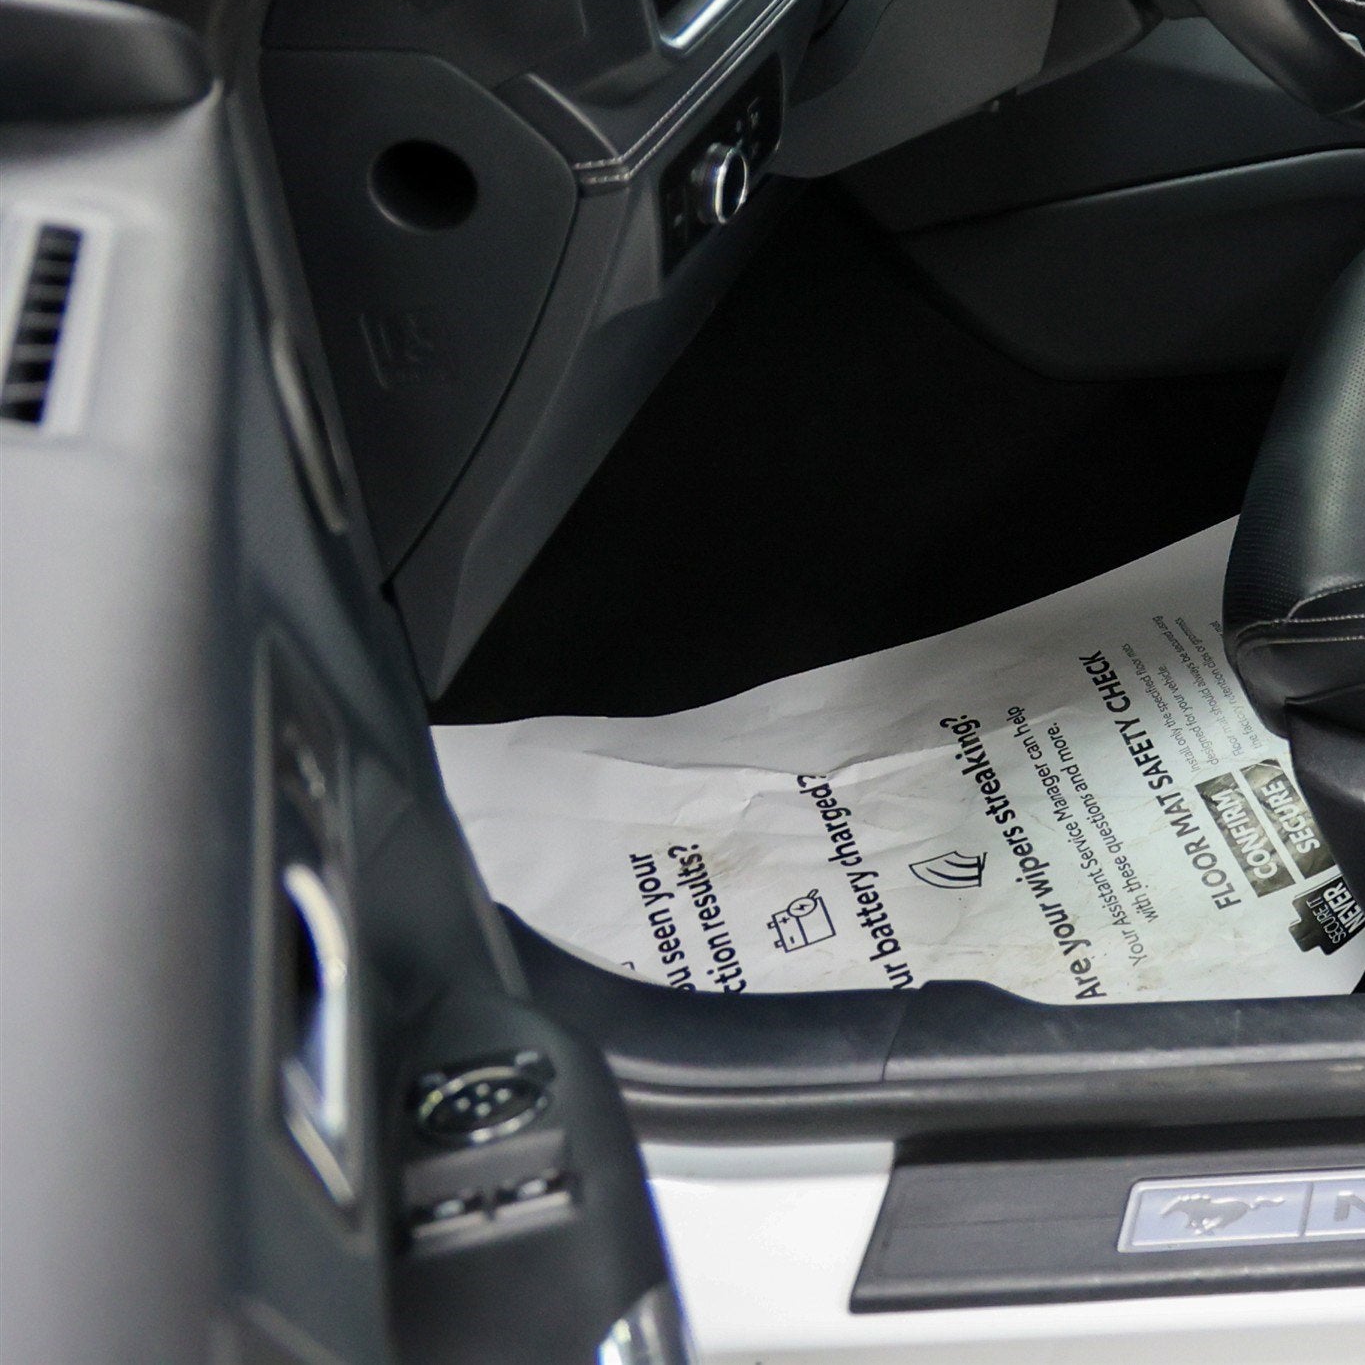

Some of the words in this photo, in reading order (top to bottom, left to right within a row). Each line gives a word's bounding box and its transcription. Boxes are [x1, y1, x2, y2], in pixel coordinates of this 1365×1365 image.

[1078, 649, 1132, 713] CHECK
[1140, 675, 1169, 713] specified
[1174, 693, 1188, 712] your
[1007, 706, 1032, 738] help
[1047, 721, 1075, 764] more.
[1168, 722, 1187, 747] only
[1191, 725, 1219, 766] designed
[938, 714, 1017, 825] streaking?
[1022, 734, 1043, 763] can
[1114, 717, 1174, 791] SAFETY
[1034, 762, 1071, 823] Manager
[1060, 762, 1088, 793] and
[796, 774, 864, 868] charged?
[1079, 792, 1124, 854] questions
[1155, 791, 1201, 839] MAT
[1211, 788, 1278, 879] CONFIRM
[1261, 779, 1320, 854] SECURE
[1001, 825, 1058, 900] wipers
[1065, 821, 1099, 871] Service
[628, 853, 676, 908] your
[667, 843, 726, 933] results?
[1087, 867, 1132, 927] Assistant
[1114, 855, 1142, 894] these
[1183, 834, 1242, 911] FLOOR
[846, 869, 902, 962] battery
[1039, 902, 1092, 957] your
[1131, 892, 1160, 923] with
[1312, 905, 1347, 944] SECURE
[647, 908, 686, 965] seen
[706, 931, 748, 994] ction
[1122, 929, 1148, 968] Your
[667, 965, 697, 993] ou
[883, 961, 914, 991] ur
[1070, 956, 1108, 1001] Are
